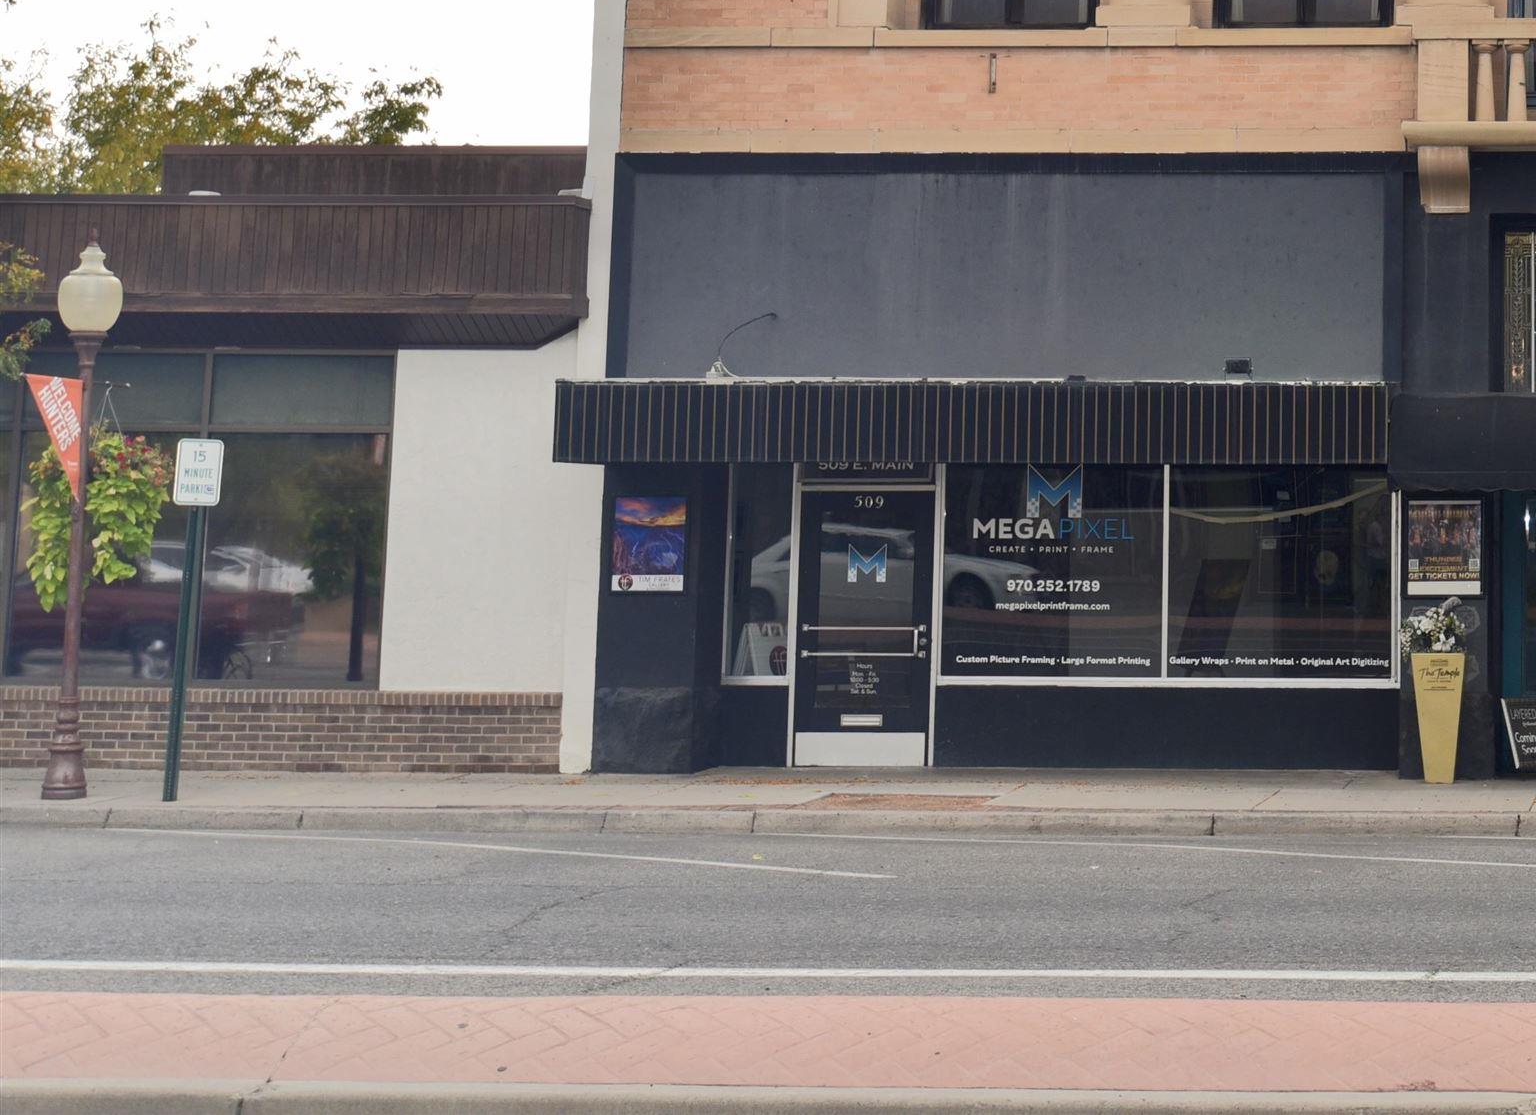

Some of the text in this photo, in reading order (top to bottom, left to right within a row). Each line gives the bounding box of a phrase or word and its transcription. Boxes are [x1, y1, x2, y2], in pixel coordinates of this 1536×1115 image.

[49, 376, 82, 443] WELCOME
[37, 385, 73, 452] HUNTERS
[194, 450, 207, 463] 15
[818, 462, 849, 470] 509
[872, 462, 914, 470] MAIN
[184, 468, 214, 479] MINUTE
[180, 483, 214, 494] PARKI
[854, 495, 885, 509] 509
[989, 546, 1114, 554] CREATE PRINT FRAME
[848, 543, 887, 582] M
[1006, 580, 1101, 592] 970.252.1789
[995, 601, 1111, 611] megapixelprintframe.com
[956, 655, 1150, 666] Custom Picture Framing Large Format Printing
[1169, 656, 1200, 666] Gallery
[1201, 657, 1229, 666] Wraps
[1235, 657, 1256, 665] Print
[1270, 657, 1294, 665] Metal
[1300, 657, 1333, 667] Original
[1351, 658, 1389, 667] Digitizing
